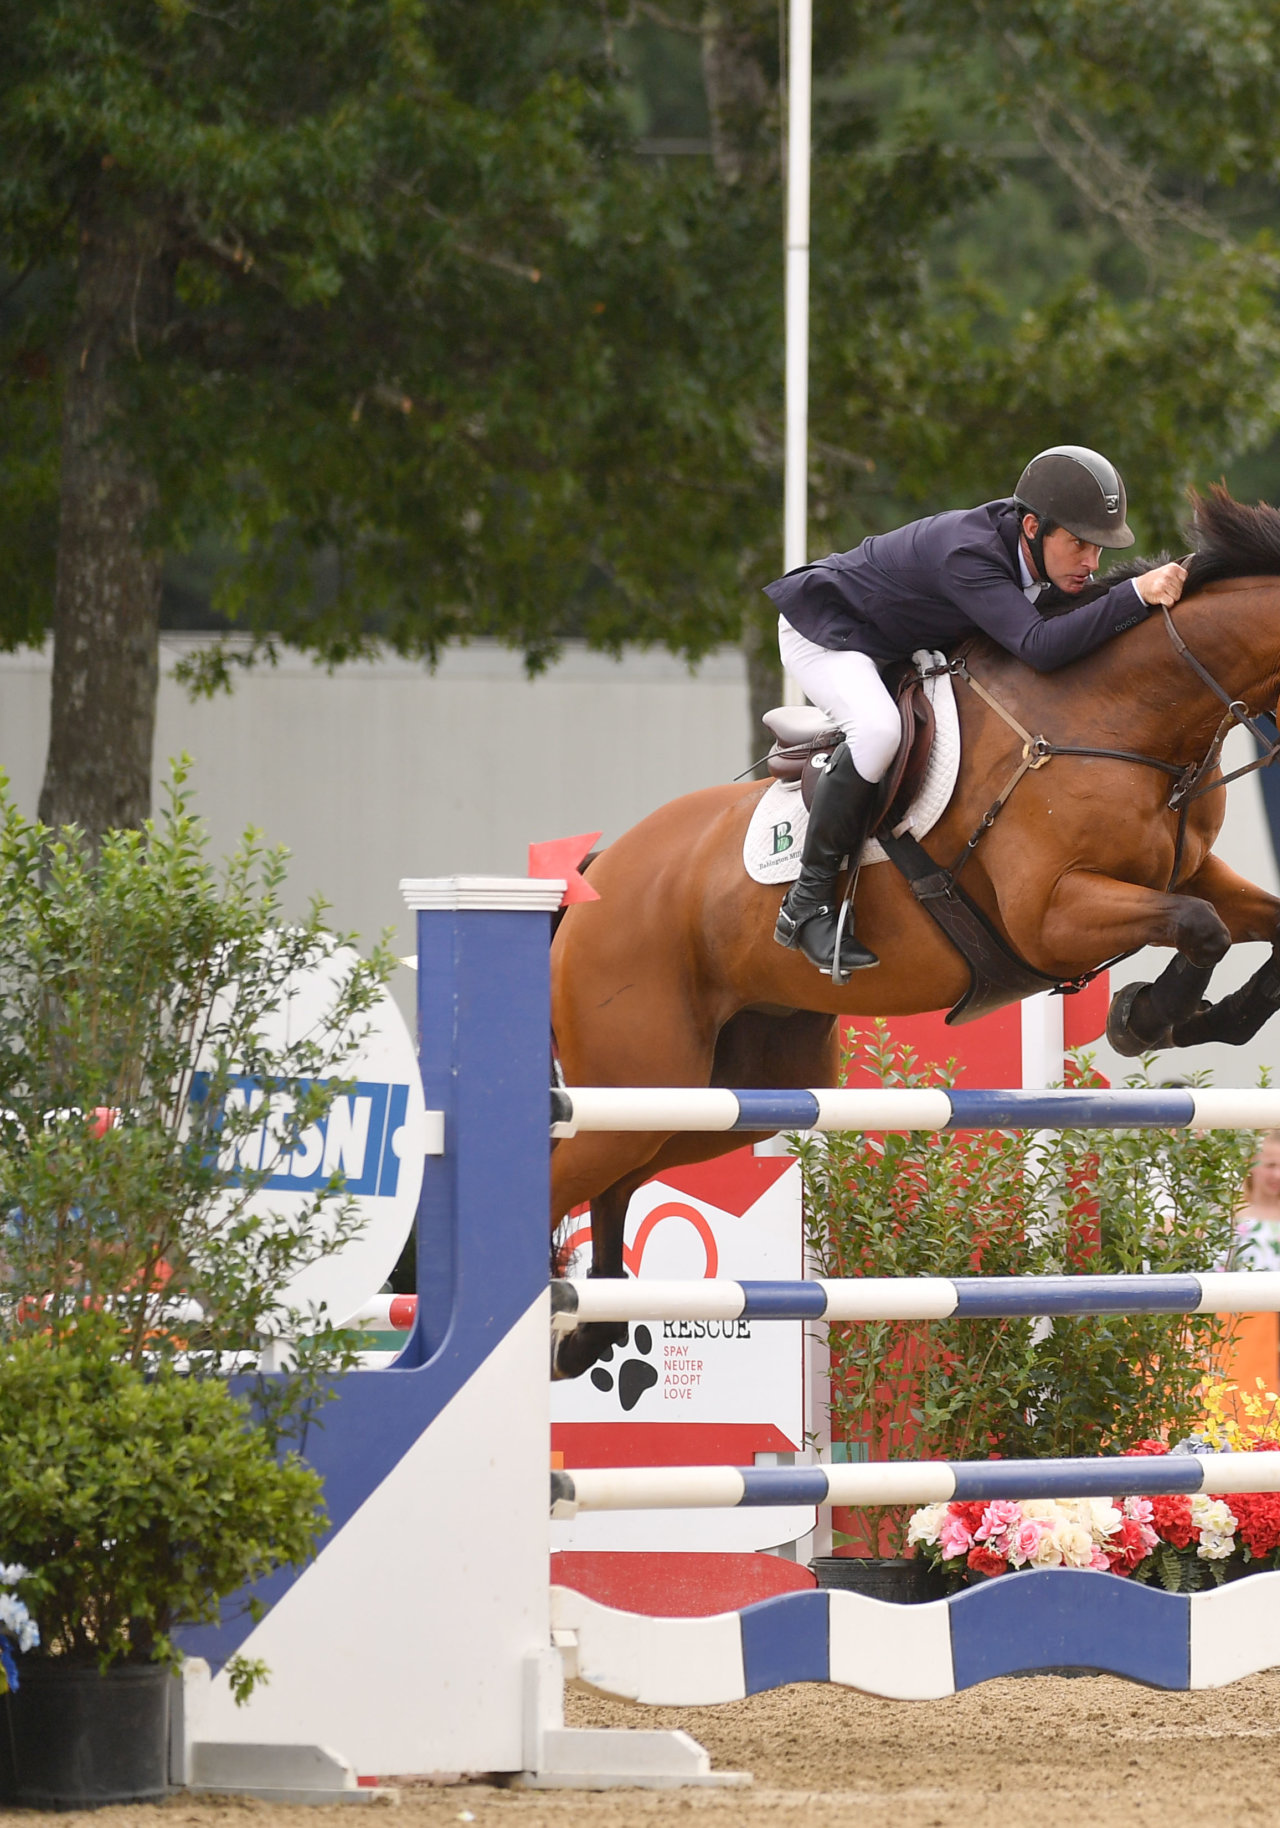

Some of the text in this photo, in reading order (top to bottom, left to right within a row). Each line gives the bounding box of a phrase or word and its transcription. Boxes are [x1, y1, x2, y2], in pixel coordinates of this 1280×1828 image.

[769, 820, 794, 856] B
[217, 1088, 373, 1180] NESN
[663, 1320, 751, 1339] RESCUE
[663, 1345, 689, 1357] SPAY
[663, 1360, 703, 1371] NEUTER
[664, 1374, 701, 1385] ADOPT
[664, 1388, 692, 1399] LOVE
